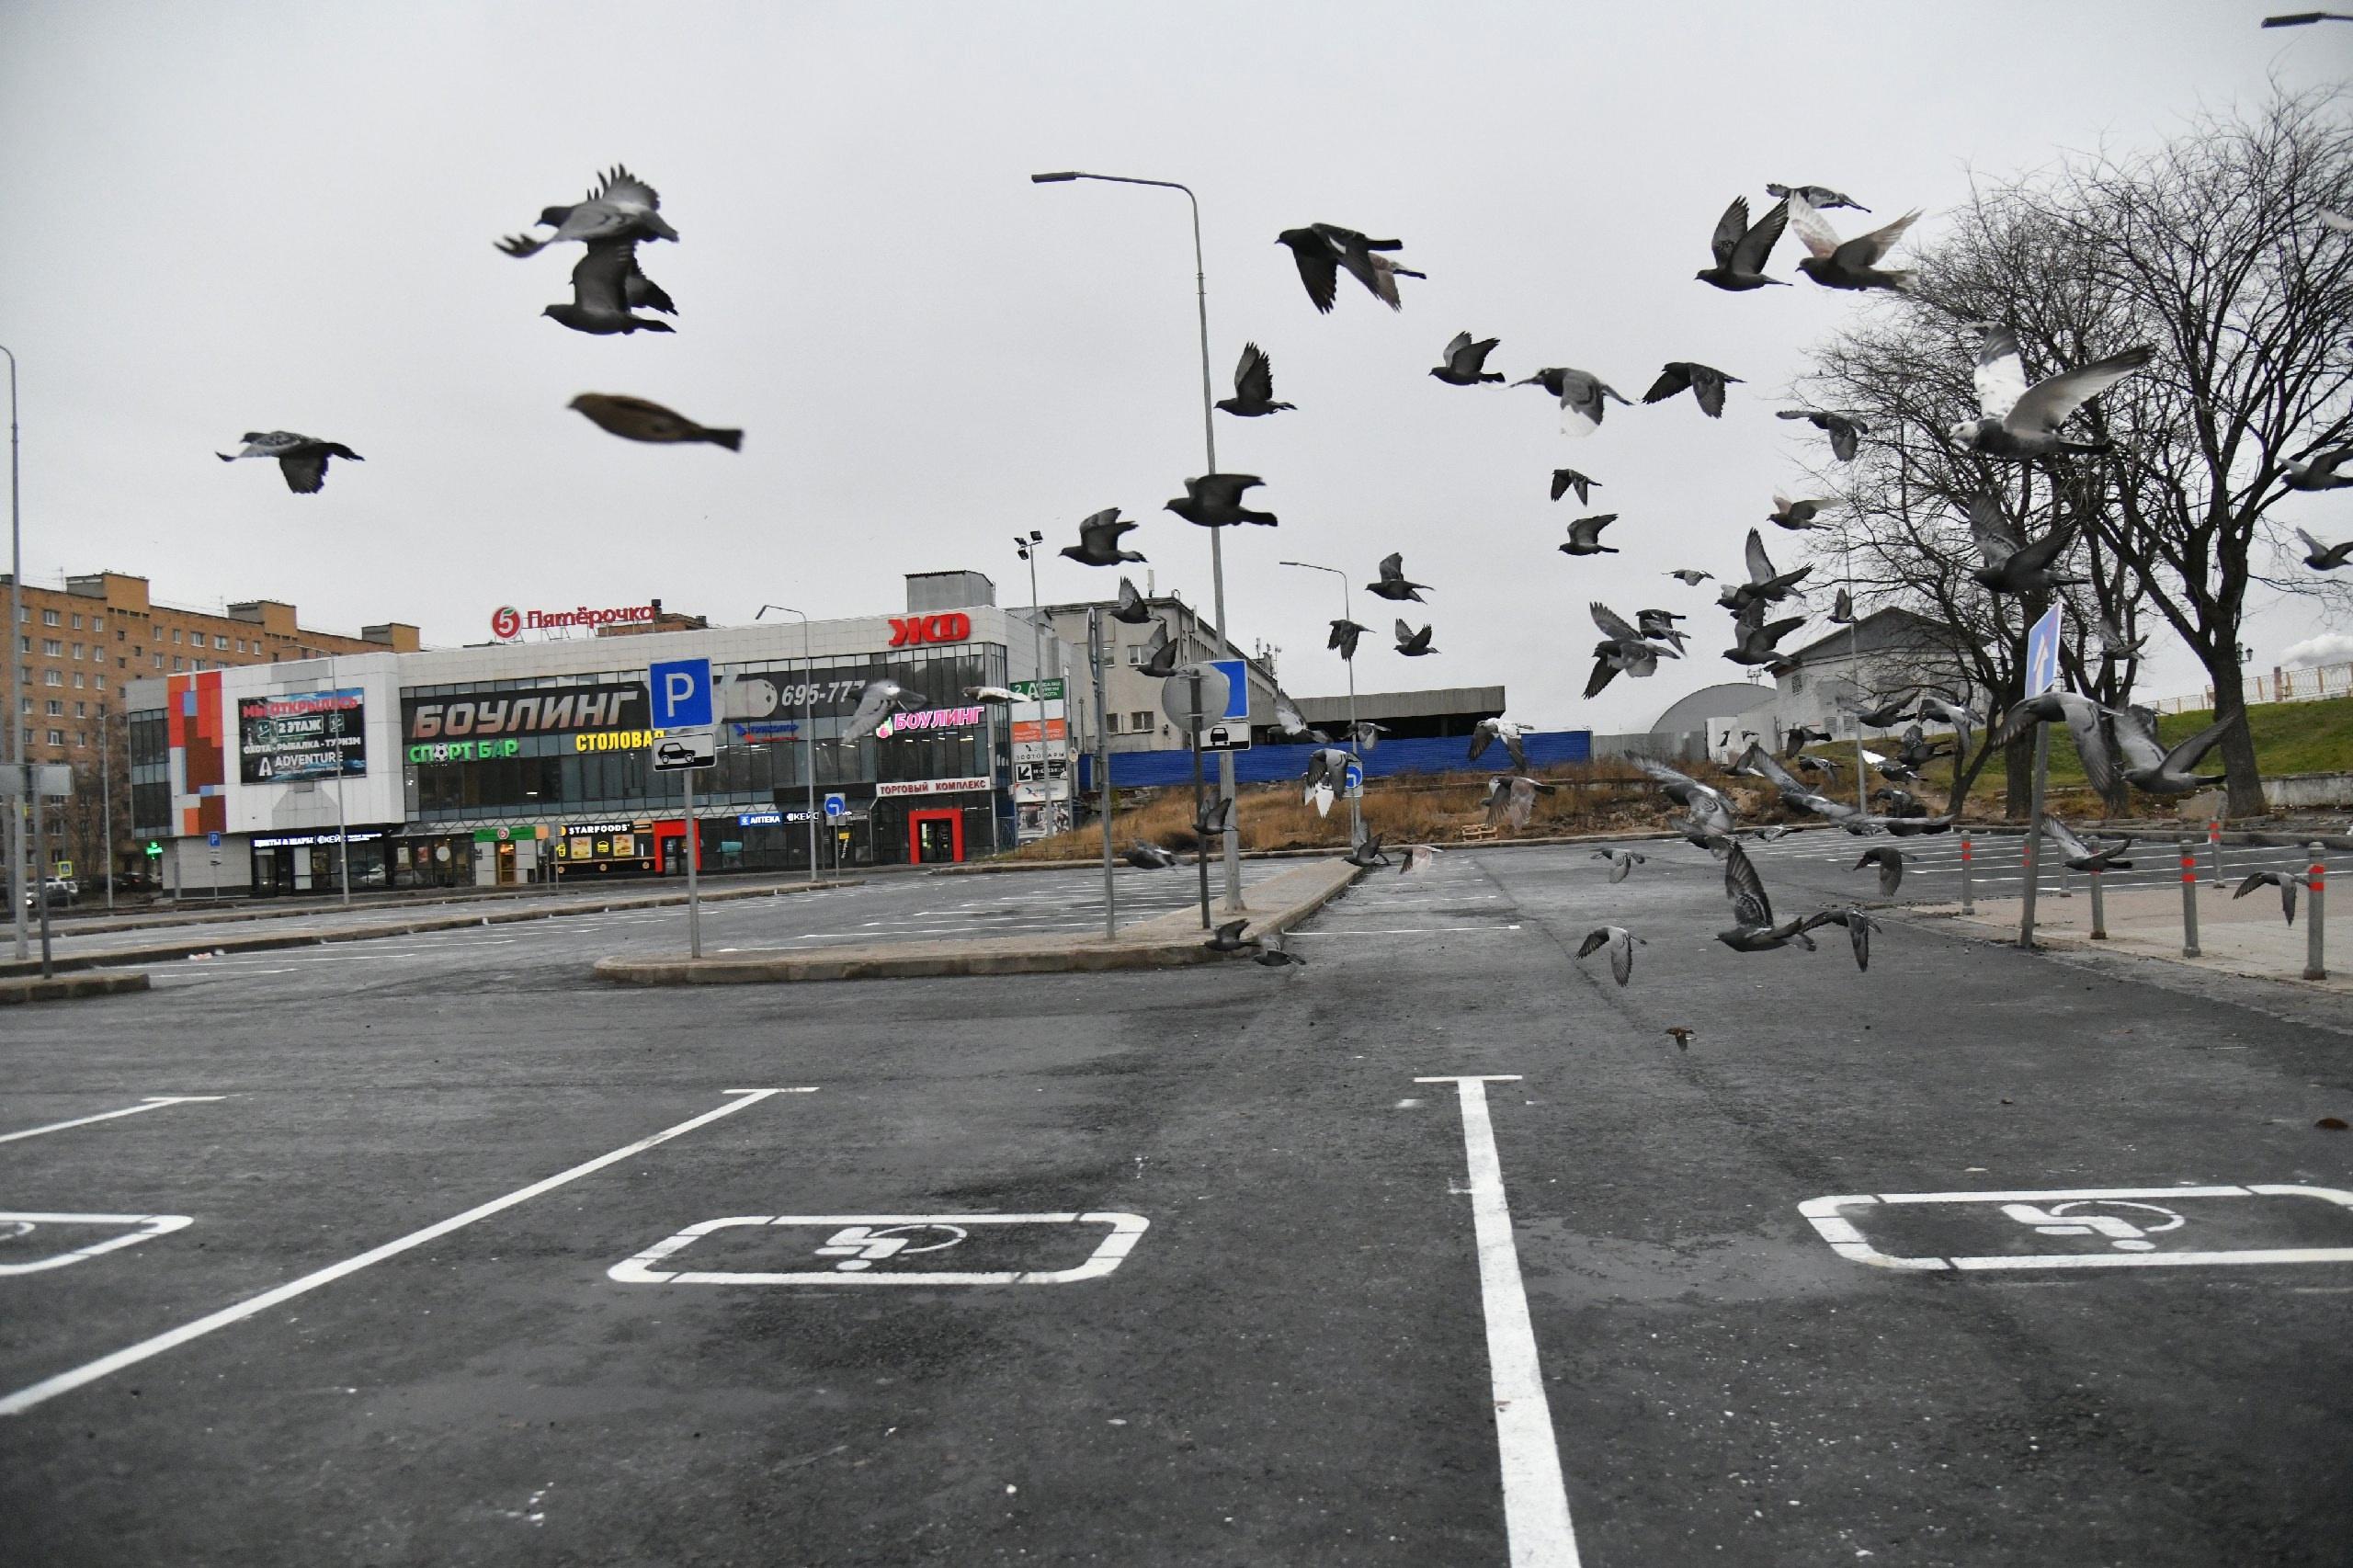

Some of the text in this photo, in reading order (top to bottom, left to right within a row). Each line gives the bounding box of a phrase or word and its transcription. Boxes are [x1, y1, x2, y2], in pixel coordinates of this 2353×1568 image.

[528, 607, 655, 629] Пятёрочка
[242, 698, 358, 719] МЫ ОТКРЫЛИСЬ
[413, 690, 638, 738] БОУЛИНГ
[278, 719, 323, 733] 2 ЭТАЖ
[894, 706, 984, 730] БОУЛИНГ
[244, 744, 271, 754] ОХОТА
[277, 741, 320, 752] РЫБАЛКА
[324, 737, 361, 747] ТУРИЗМ
[478, 739, 519, 758] БАР
[275, 751, 344, 767] ADVENTURE
[1016, 752, 1066, 761] ЗООТОАРЫ
[880, 779, 986, 795] ТОРГОВЫЙ КОМПЛЕКС
[750, 815, 780, 824] АПТЕКА
